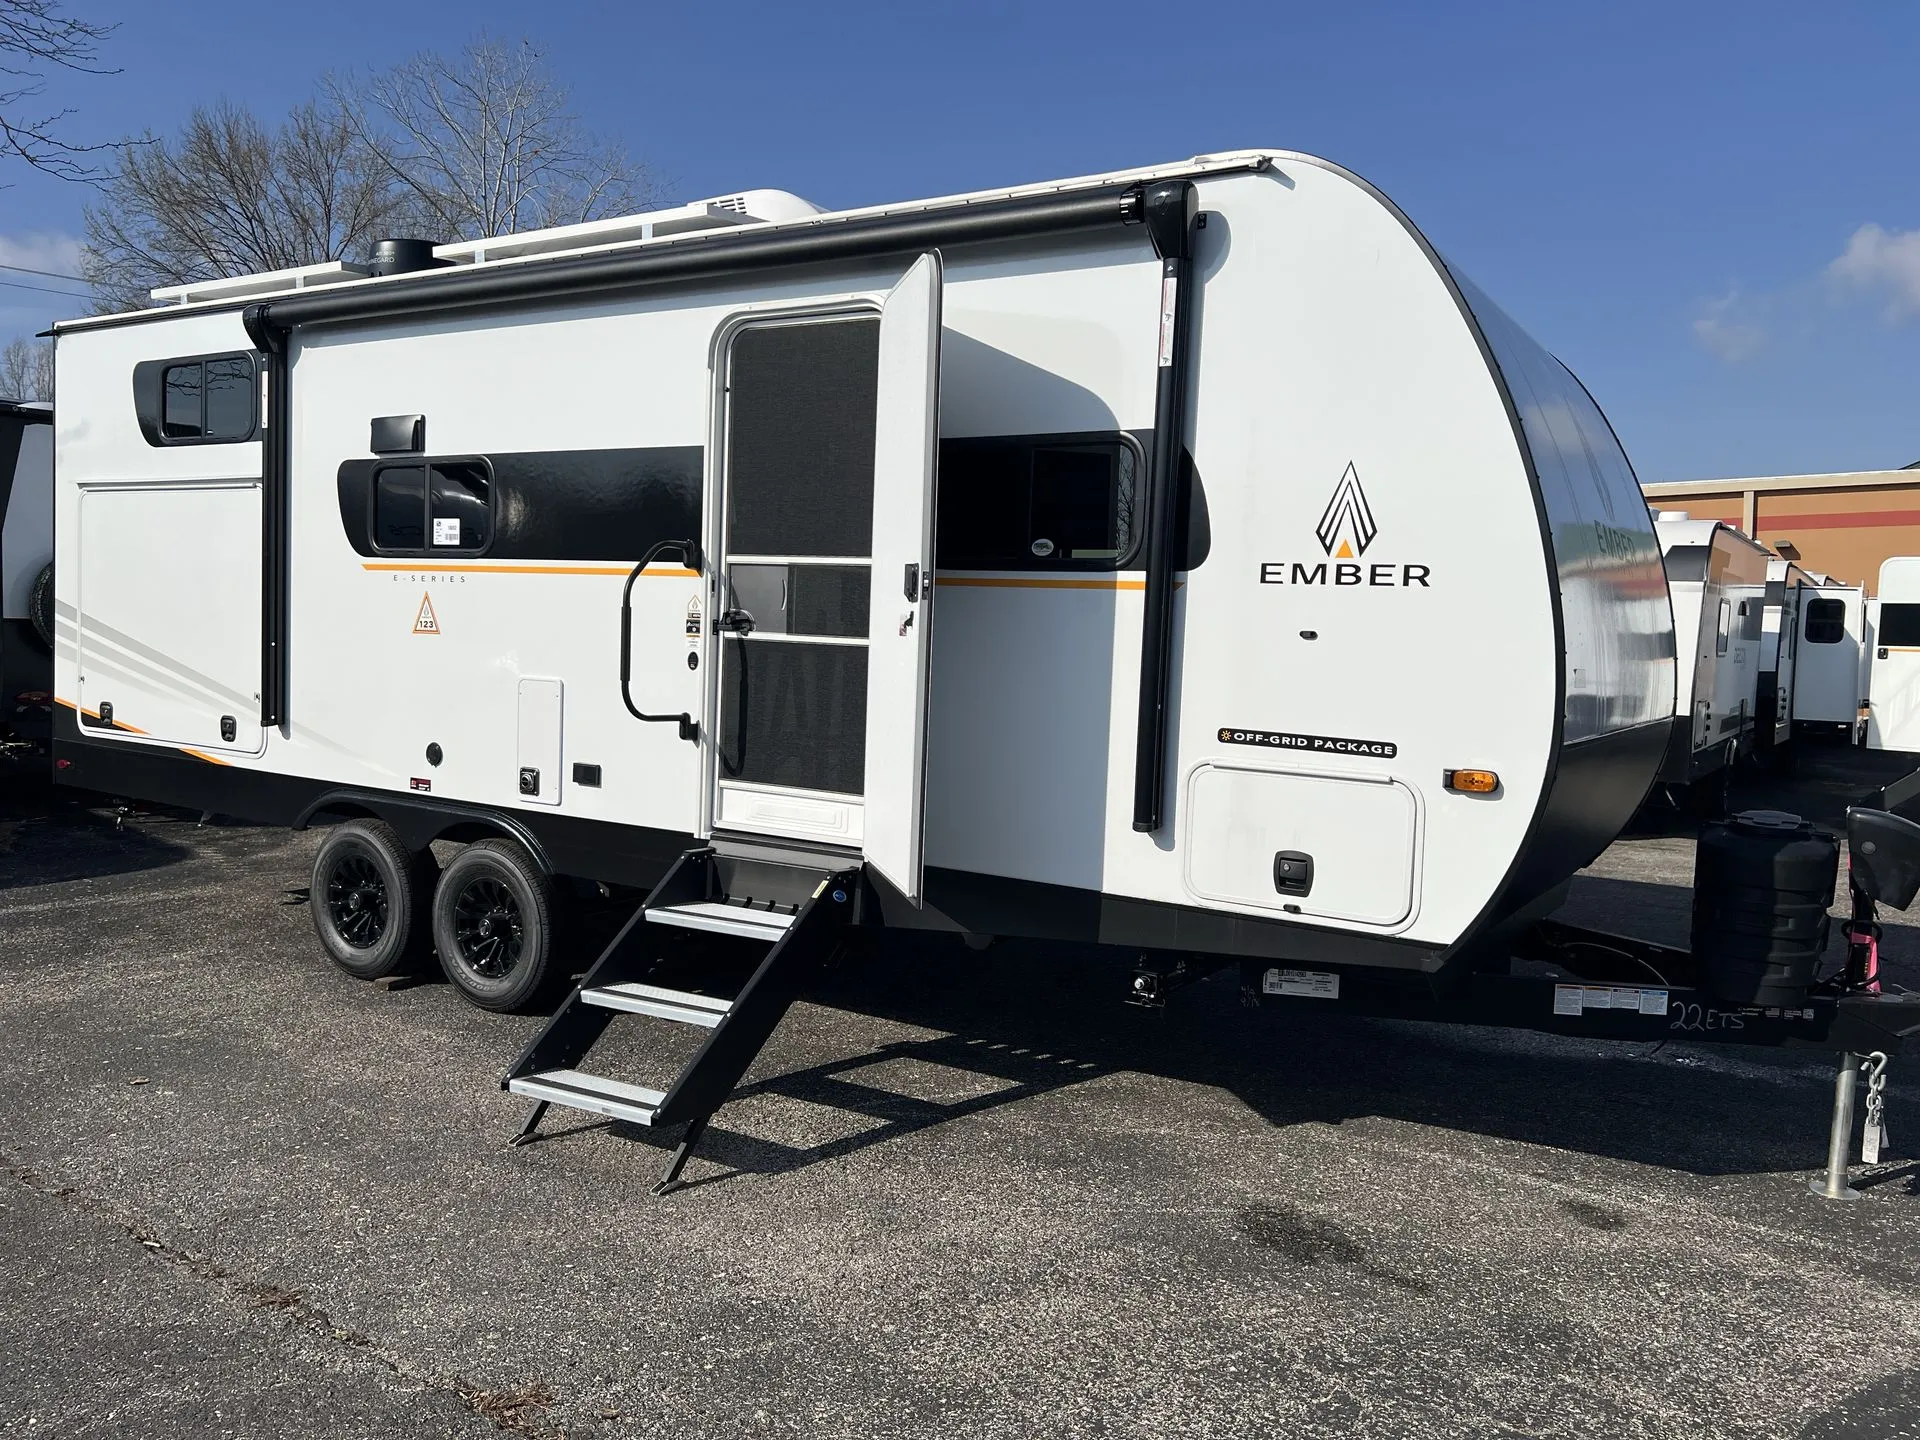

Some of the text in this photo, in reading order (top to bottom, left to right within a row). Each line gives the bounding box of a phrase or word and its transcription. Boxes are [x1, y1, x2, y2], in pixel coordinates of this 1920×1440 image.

[1260, 562, 1431, 588] EMBER
[419, 620, 434, 629] 123
[1233, 732, 1394, 755] OFF-GRID PACKAGE
